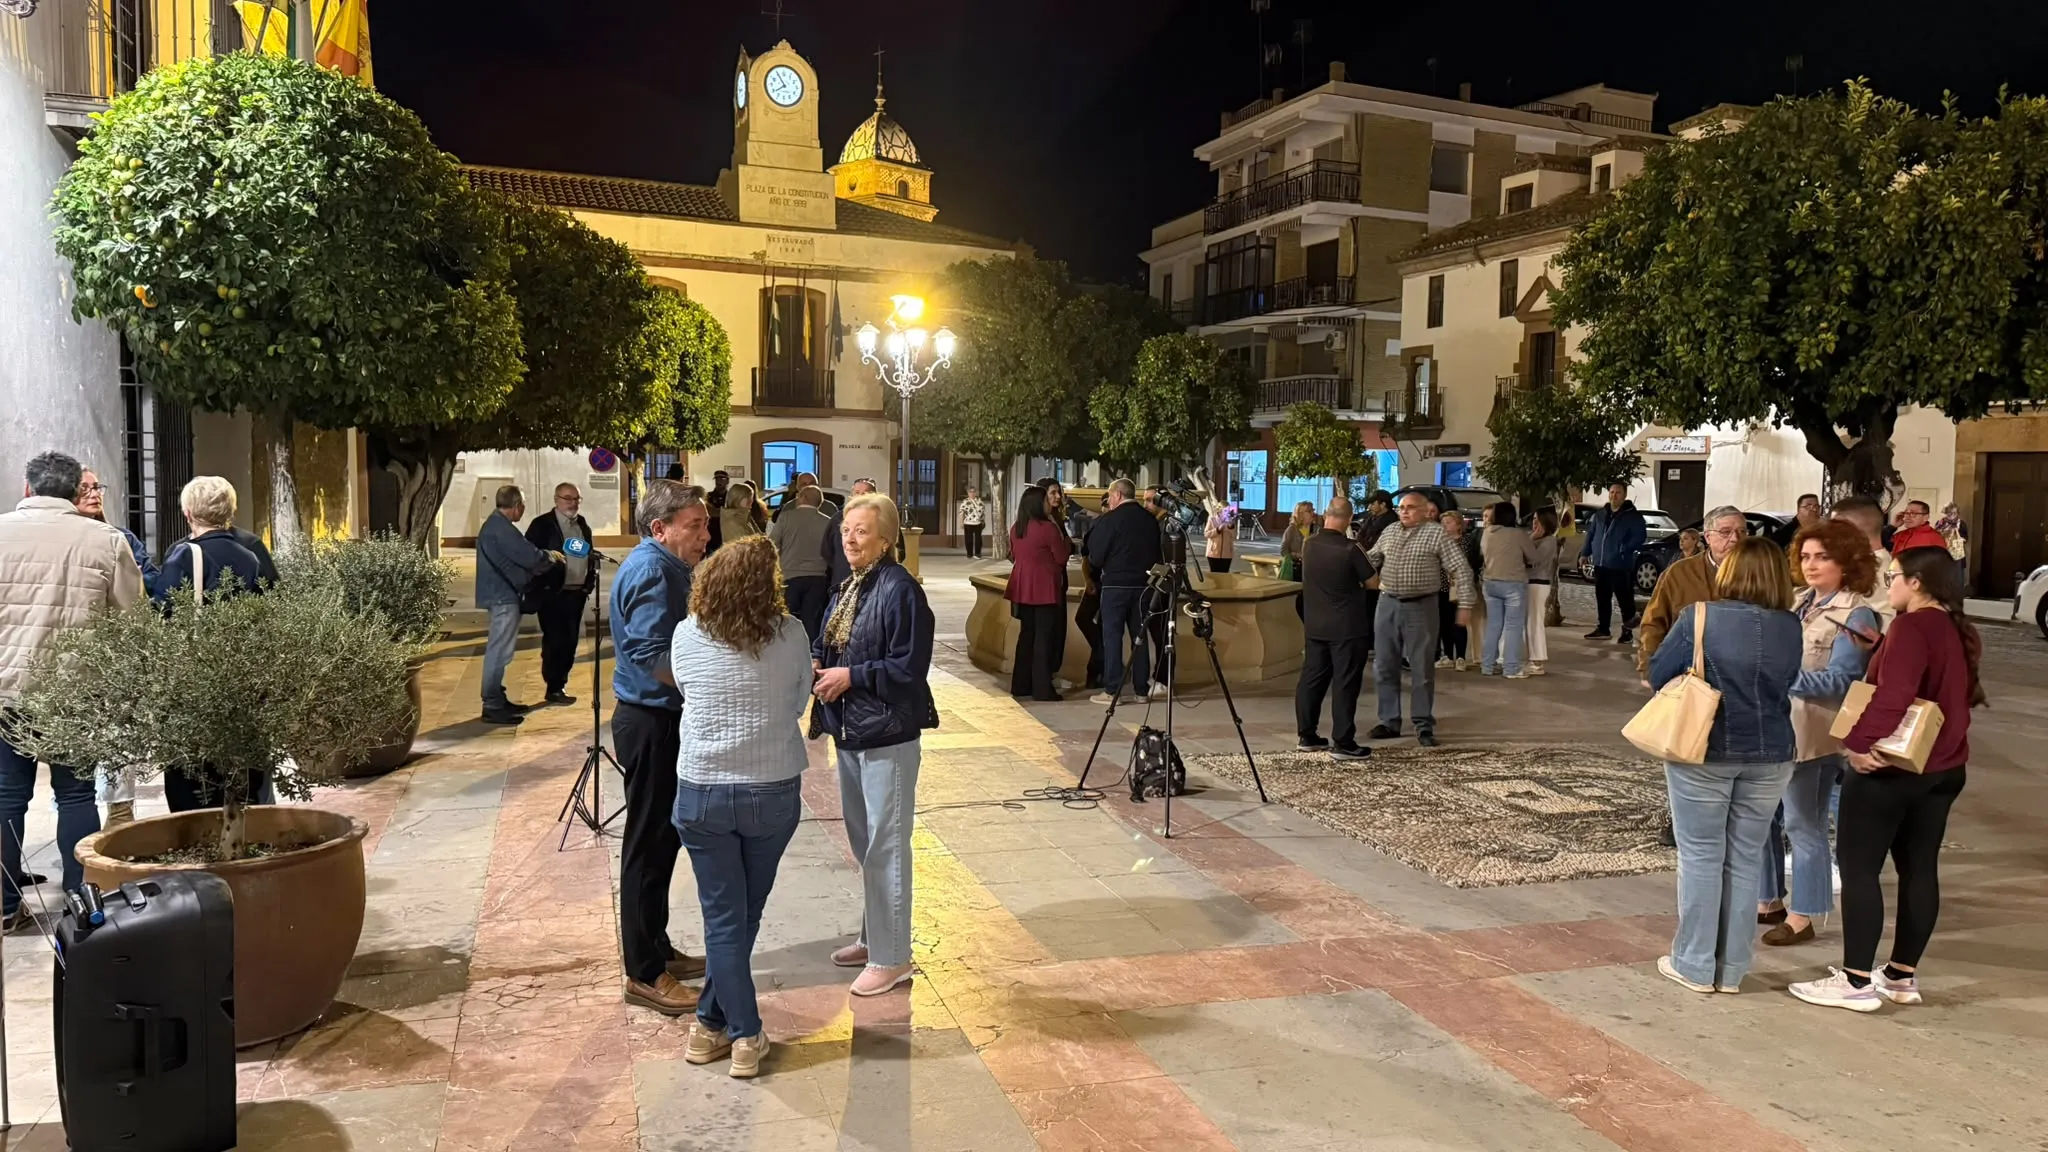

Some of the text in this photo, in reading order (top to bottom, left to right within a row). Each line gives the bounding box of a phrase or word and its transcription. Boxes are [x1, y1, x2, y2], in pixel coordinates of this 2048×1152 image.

[746, 184, 766, 193] PLAZA
[768, 186, 777, 195] DE
[778, 187, 786, 196] LA
[769, 196, 781, 206] AÑO
[783, 198, 792, 207] DE
